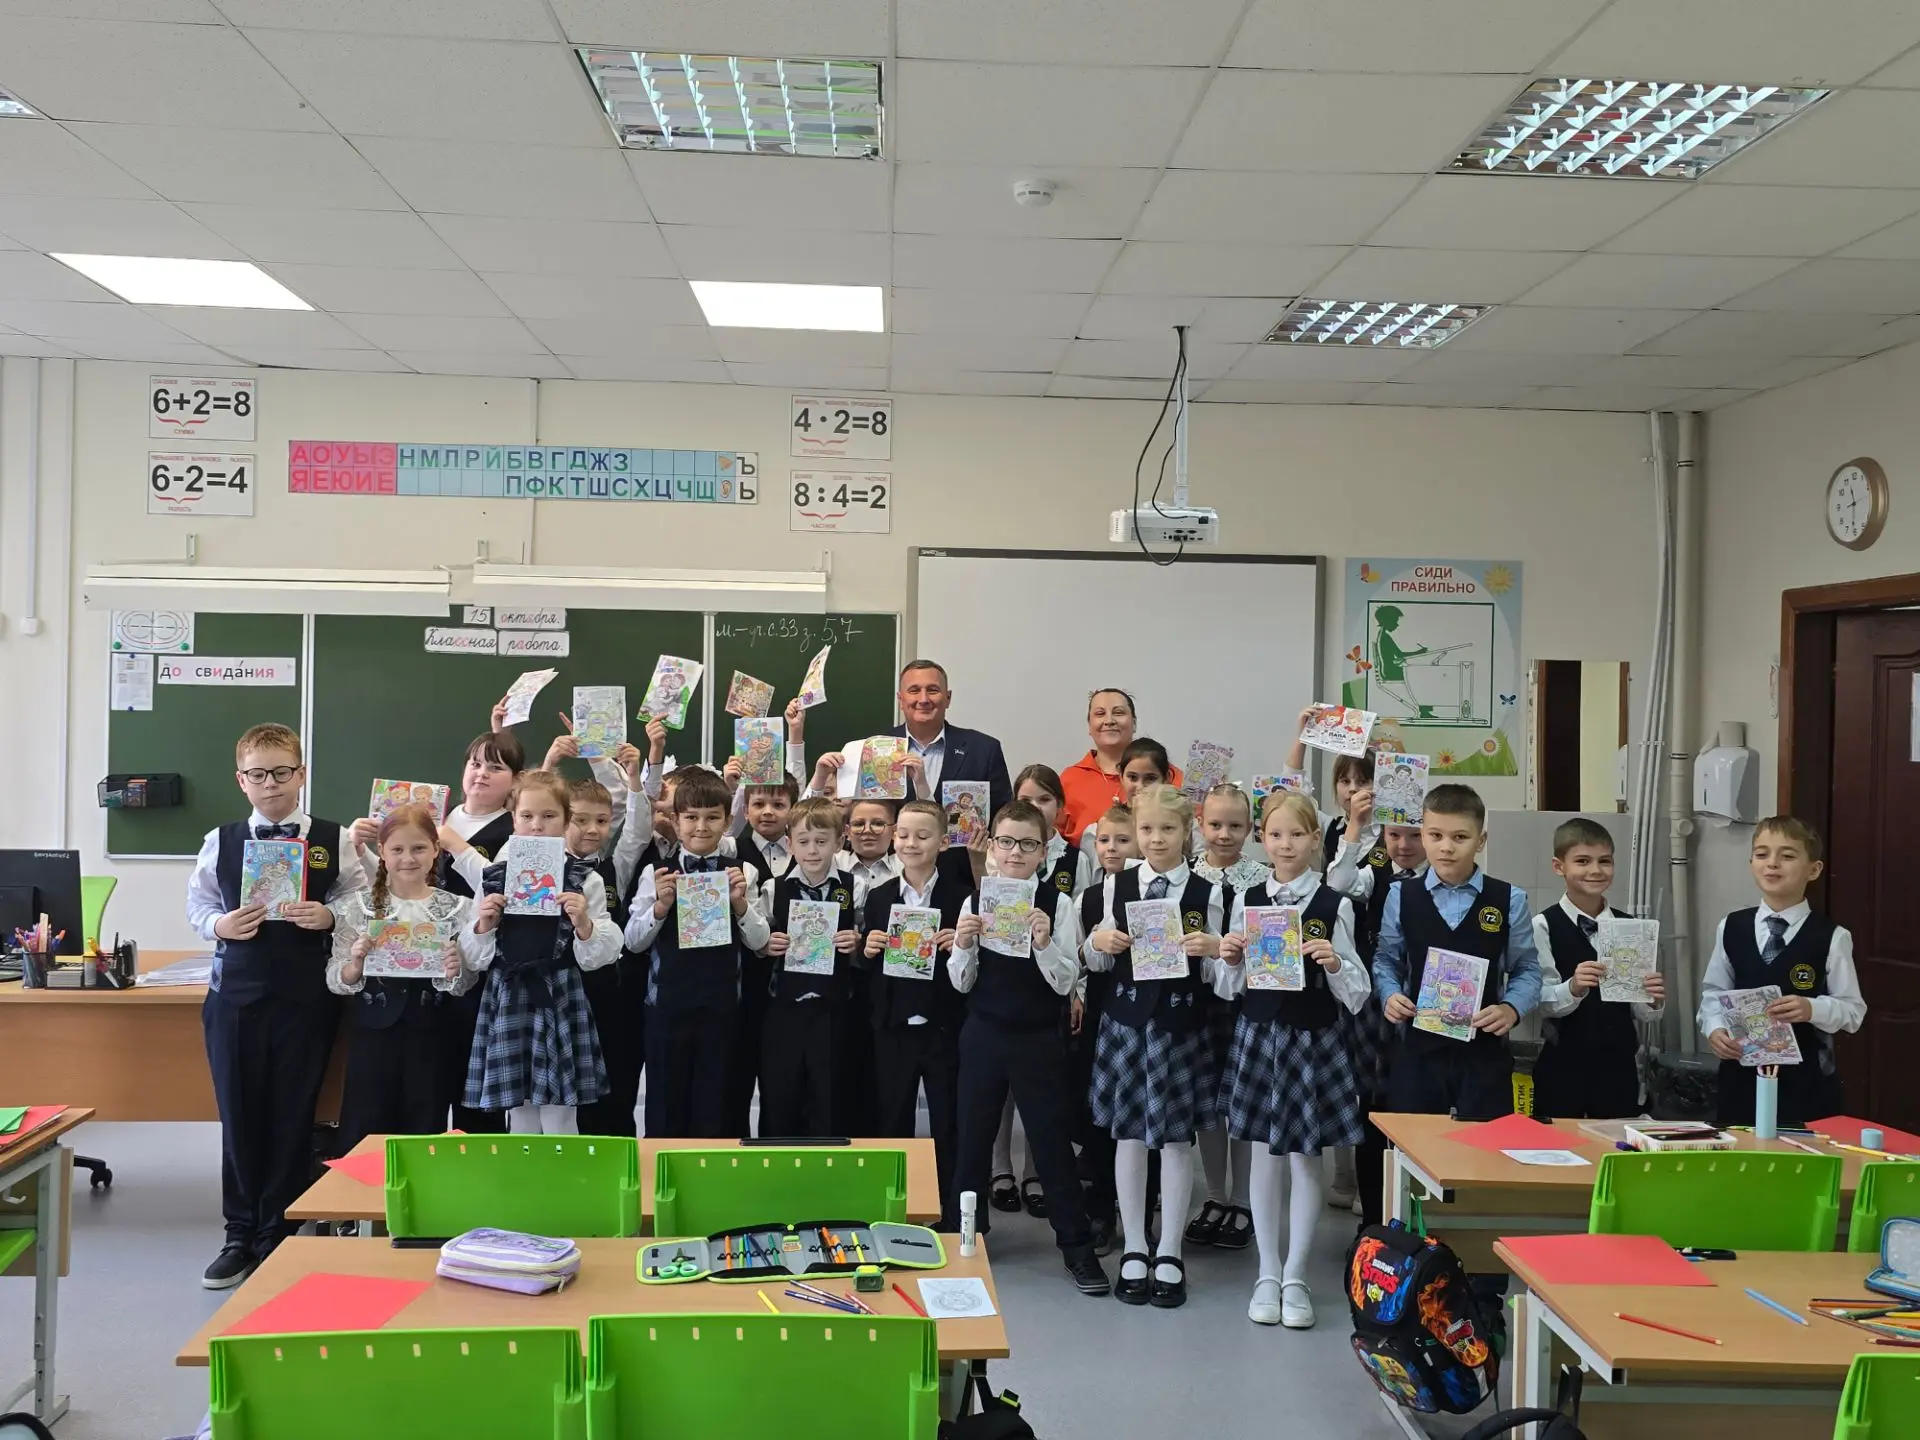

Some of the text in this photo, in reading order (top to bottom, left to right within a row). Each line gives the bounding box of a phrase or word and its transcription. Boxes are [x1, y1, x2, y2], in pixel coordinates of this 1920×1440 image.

[153, 388, 251, 417] 6+2=8
[151, 464, 248, 494] 6-2=4
[1414, 566, 1453, 580] СИДИ
[1391, 581, 1476, 594] ПРАВИЛЬНО
[470, 607, 490, 624] 15
[313, 852, 324, 860] 72
[1189, 918, 1199, 926] 72
[1485, 914, 1497, 922] 72
[1308, 926, 1320, 935] 72
[1797, 971, 1809, 979] 72
